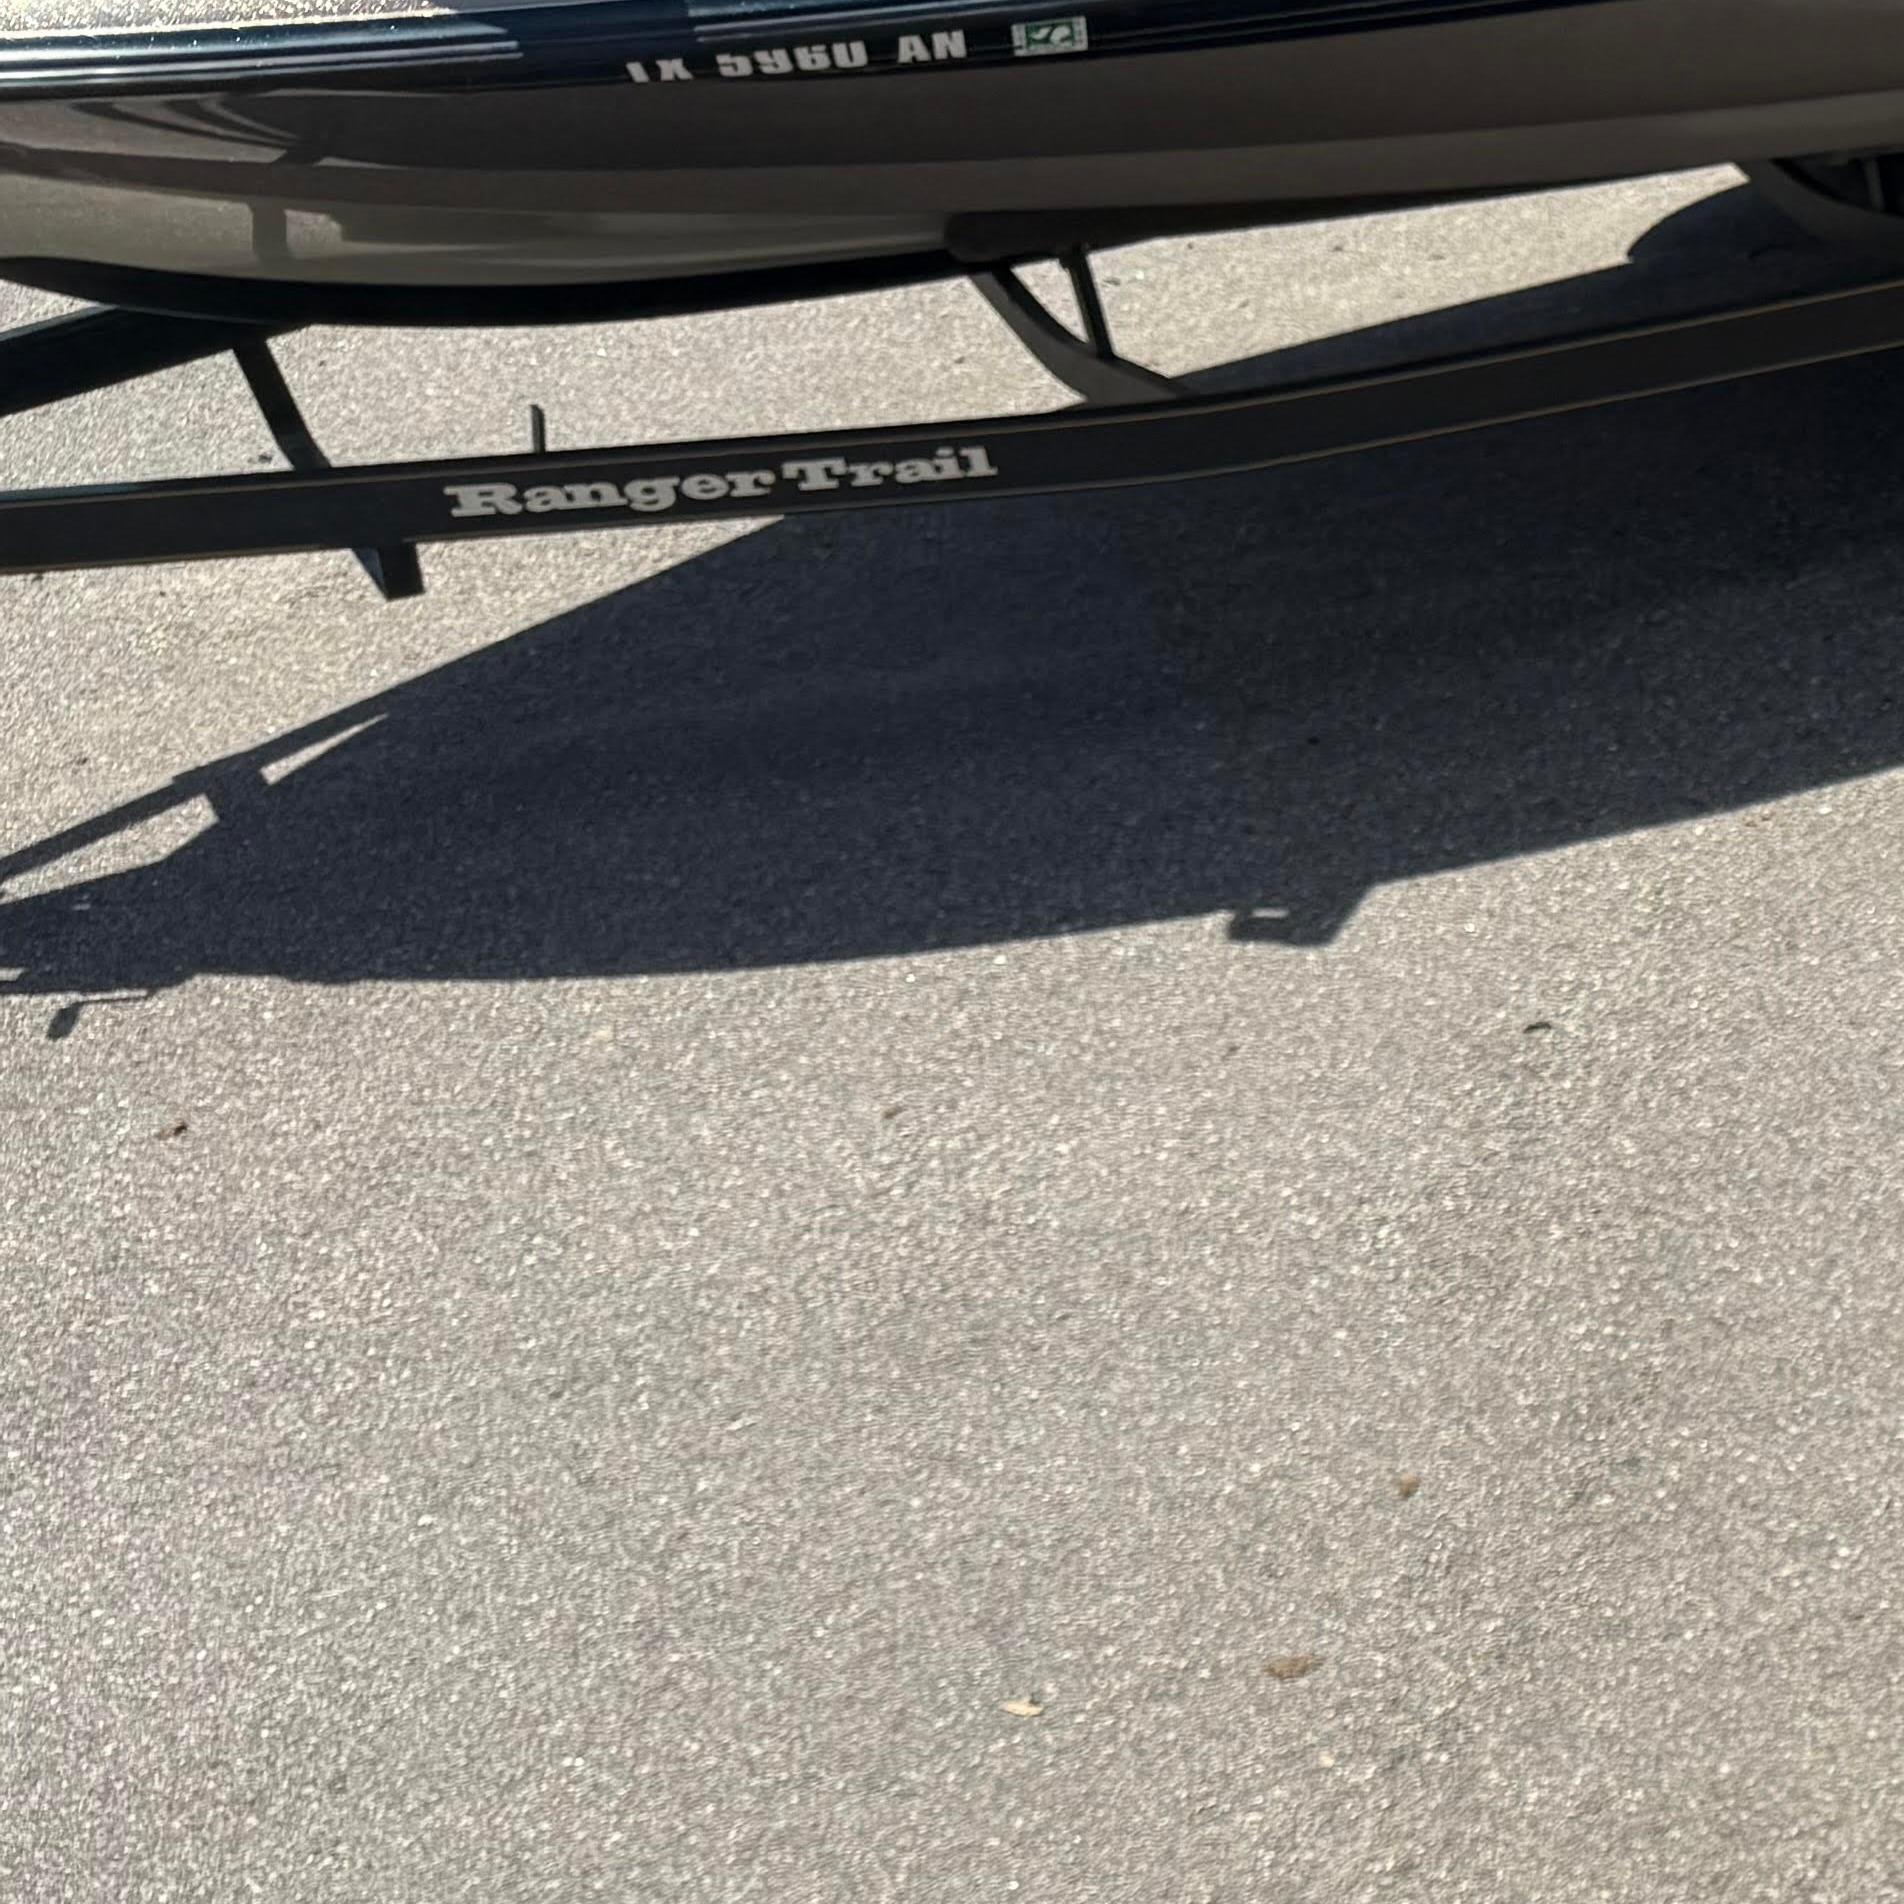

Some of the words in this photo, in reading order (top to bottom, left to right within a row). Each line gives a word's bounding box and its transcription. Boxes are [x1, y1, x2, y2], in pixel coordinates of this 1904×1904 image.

[898, 31, 966, 63] AN
[443, 470, 776, 518] Ranger
[781, 445, 999, 491] Trail
